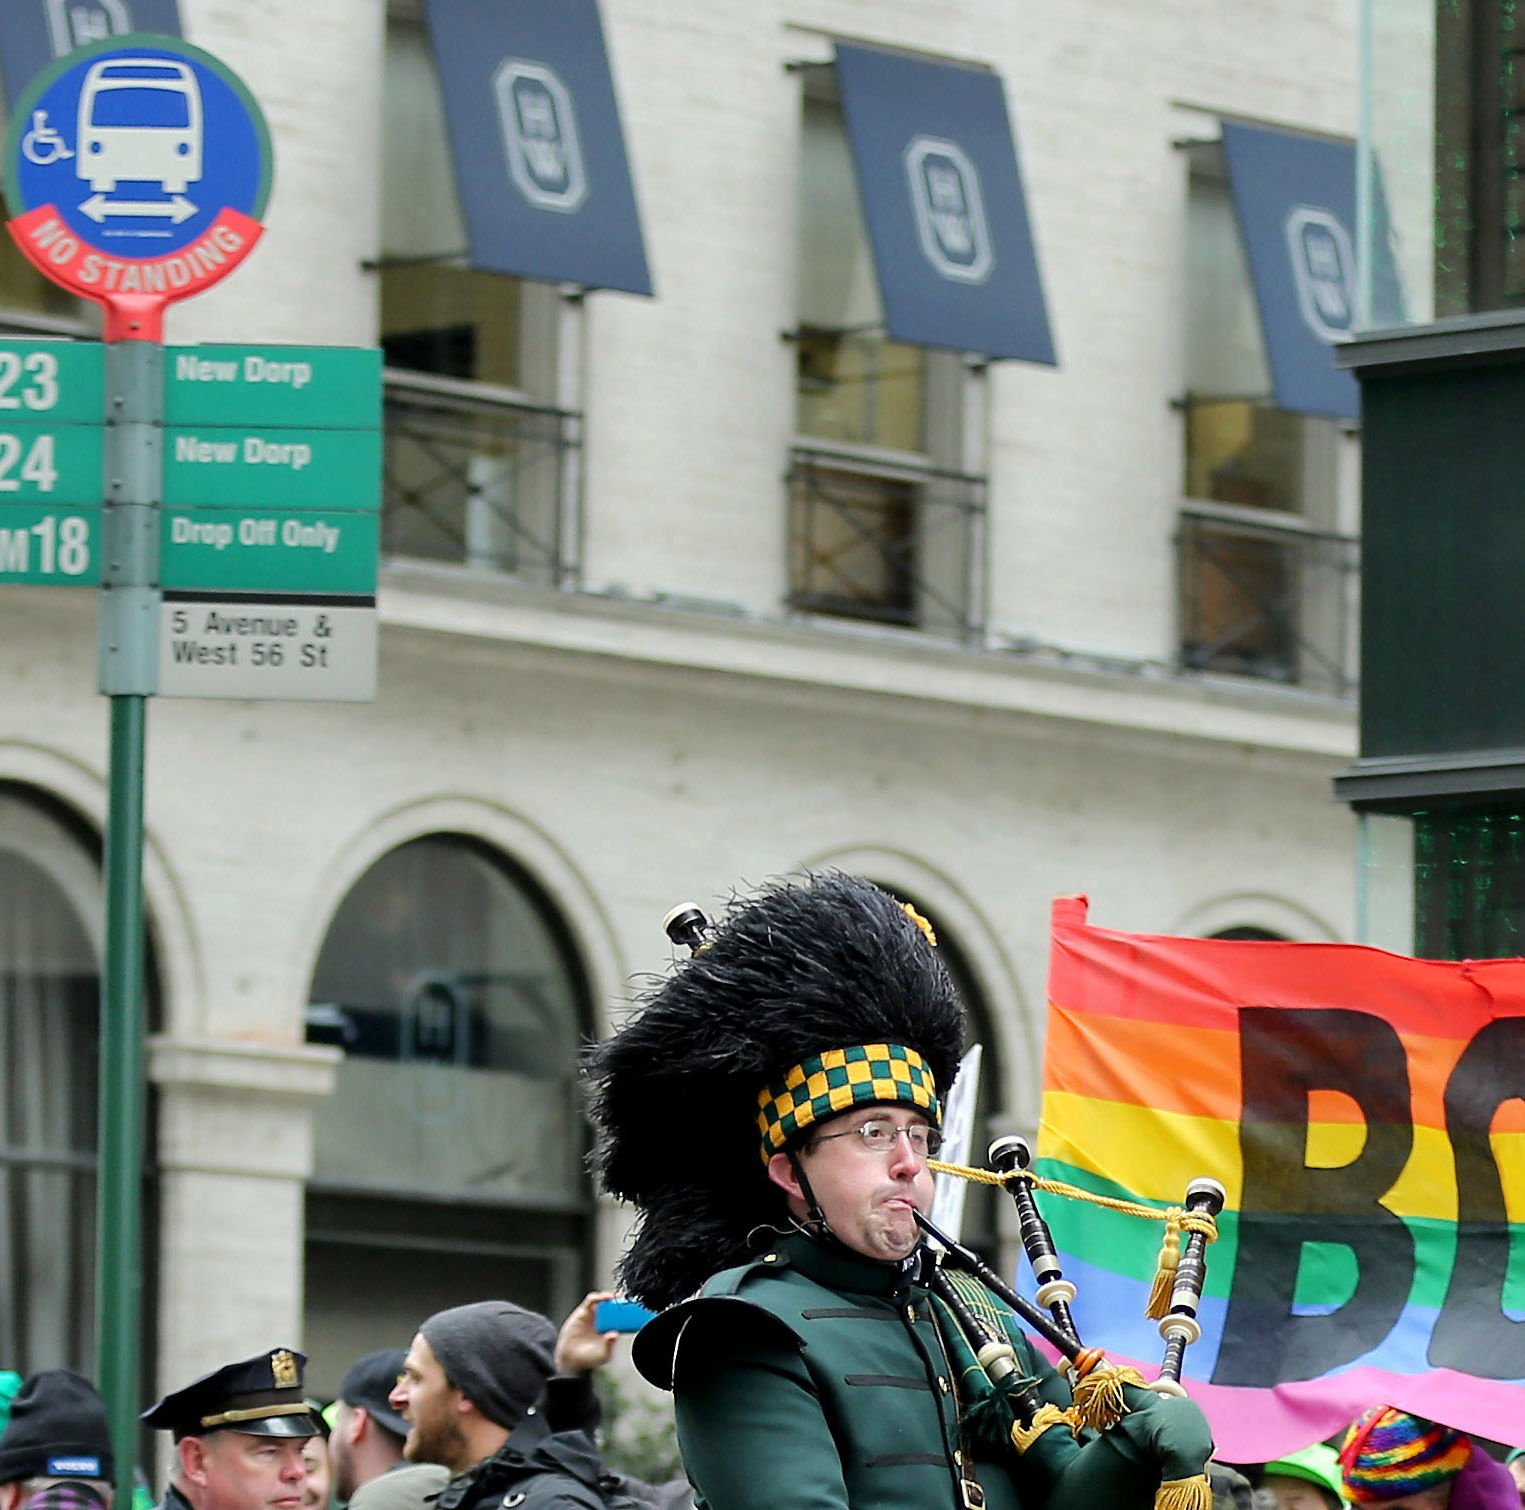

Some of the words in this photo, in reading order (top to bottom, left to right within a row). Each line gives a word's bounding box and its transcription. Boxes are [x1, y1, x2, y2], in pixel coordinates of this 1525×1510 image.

[30, 217, 79, 265] NO
[77, 224, 245, 293] STANDING
[176, 355, 239, 382] New
[243, 356, 312, 389] Dorp
[176, 436, 239, 464] New
[243, 437, 312, 471] Dorp
[172, 517, 234, 550] Drop
[239, 518, 278, 547] Off
[282, 520, 341, 554] Only
[172, 610, 189, 634] 5
[204, 611, 299, 637] Avenue
[314, 615, 333, 638] &
[172, 639, 239, 665] West
[251, 642, 285, 667] 56
[300, 643, 330, 668] St
